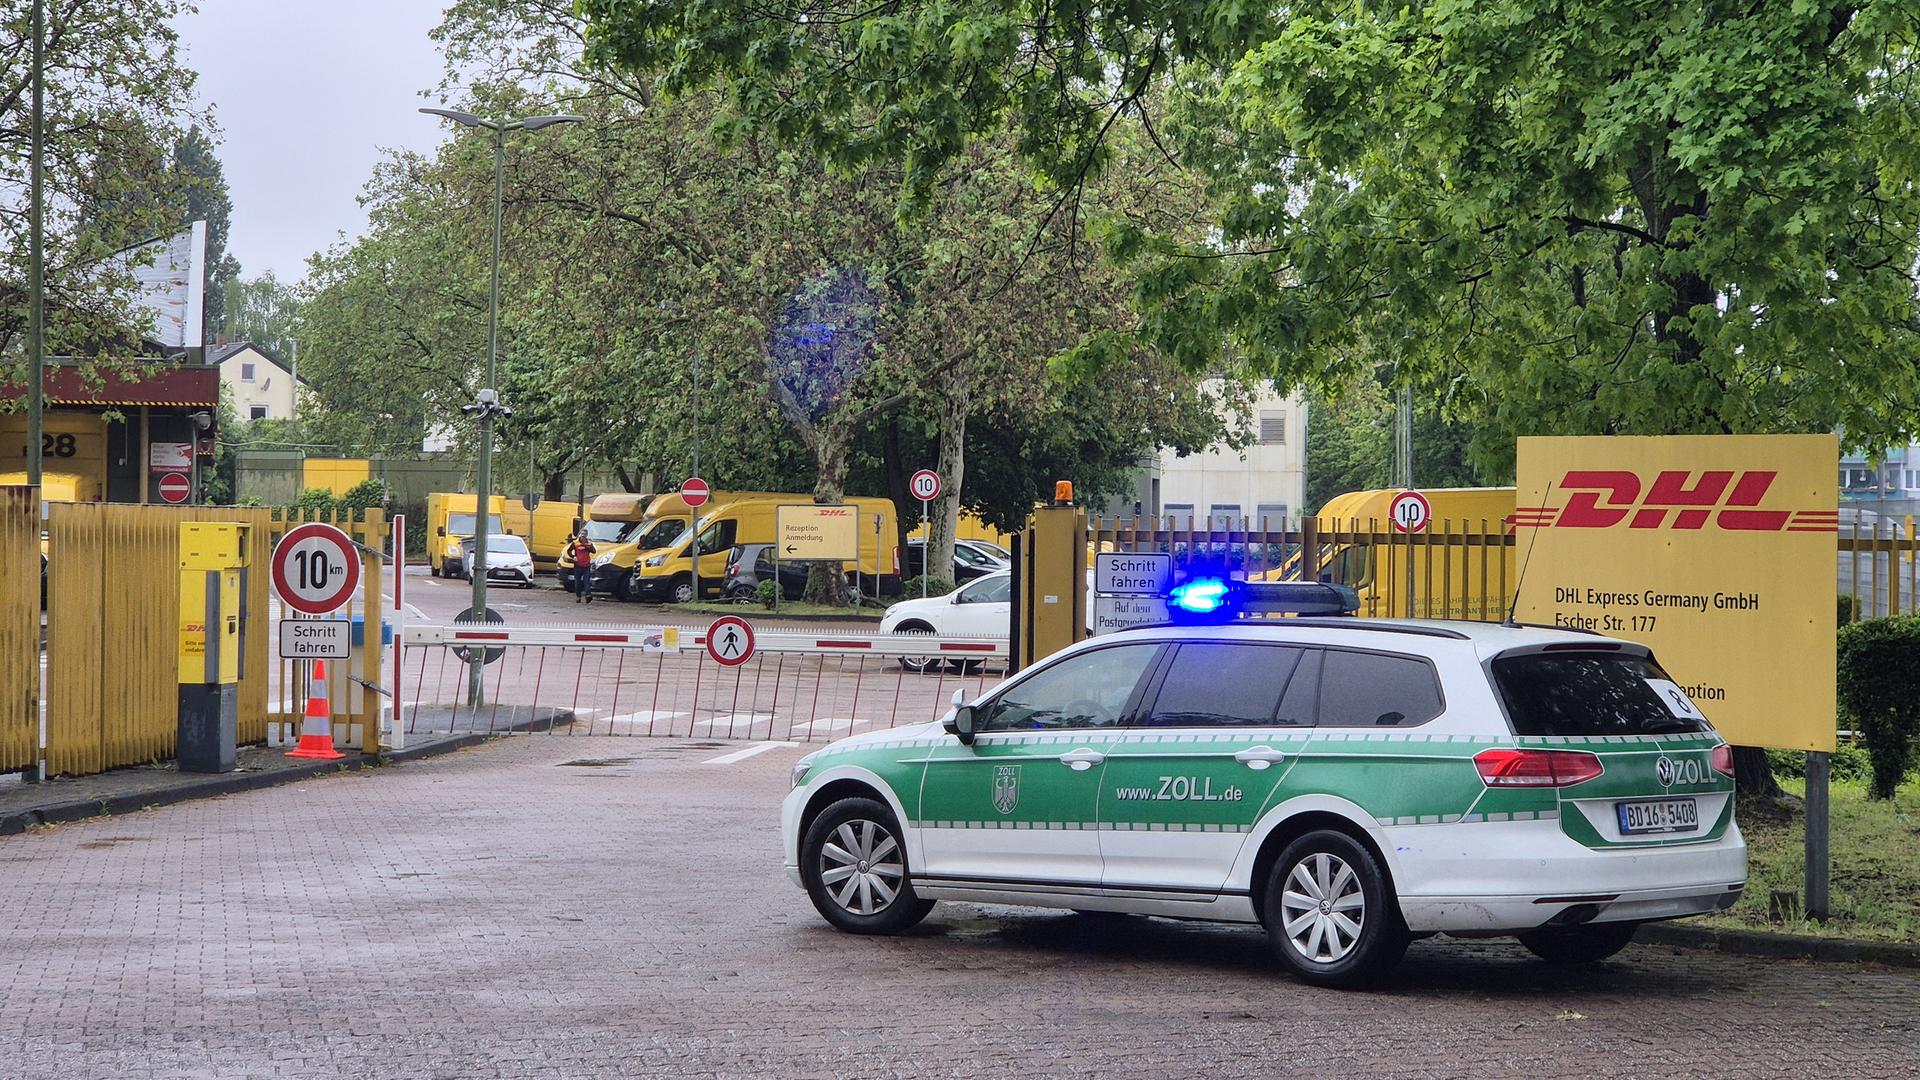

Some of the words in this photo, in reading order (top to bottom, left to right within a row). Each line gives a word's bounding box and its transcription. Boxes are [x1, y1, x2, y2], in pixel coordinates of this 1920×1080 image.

[919, 479, 932, 491] 10
[1554, 470, 1792, 531] DHL
[1400, 503, 1419, 521] 10
[785, 524, 819, 533] Rezeption
[785, 534, 823, 542] Anmeldung
[294, 550, 328, 589] 10
[329, 563, 343, 575] km
[1111, 559, 1156, 572] Schritt
[1111, 576, 1155, 588] fahren
[1115, 601, 1129, 613] Auf
[1555, 587, 1582, 604] DHL
[1587, 588, 1639, 609] Express
[1644, 590, 1709, 612] Germany
[1714, 592, 1759, 610] GmbH
[1555, 612, 1598, 629] Escher
[1603, 614, 1626, 631] Str.
[1631, 615, 1656, 632] 177
[294, 625, 336, 637] Schritt
[294, 641, 336, 653] fahren
[1668, 689, 1691, 714] 8
[998, 767, 1016, 776] ZOLL
[1674, 759, 1718, 785] ZOLL
[1116, 775, 1243, 801] www.ZOLL.de
[1667, 803, 1696, 824] 5408
